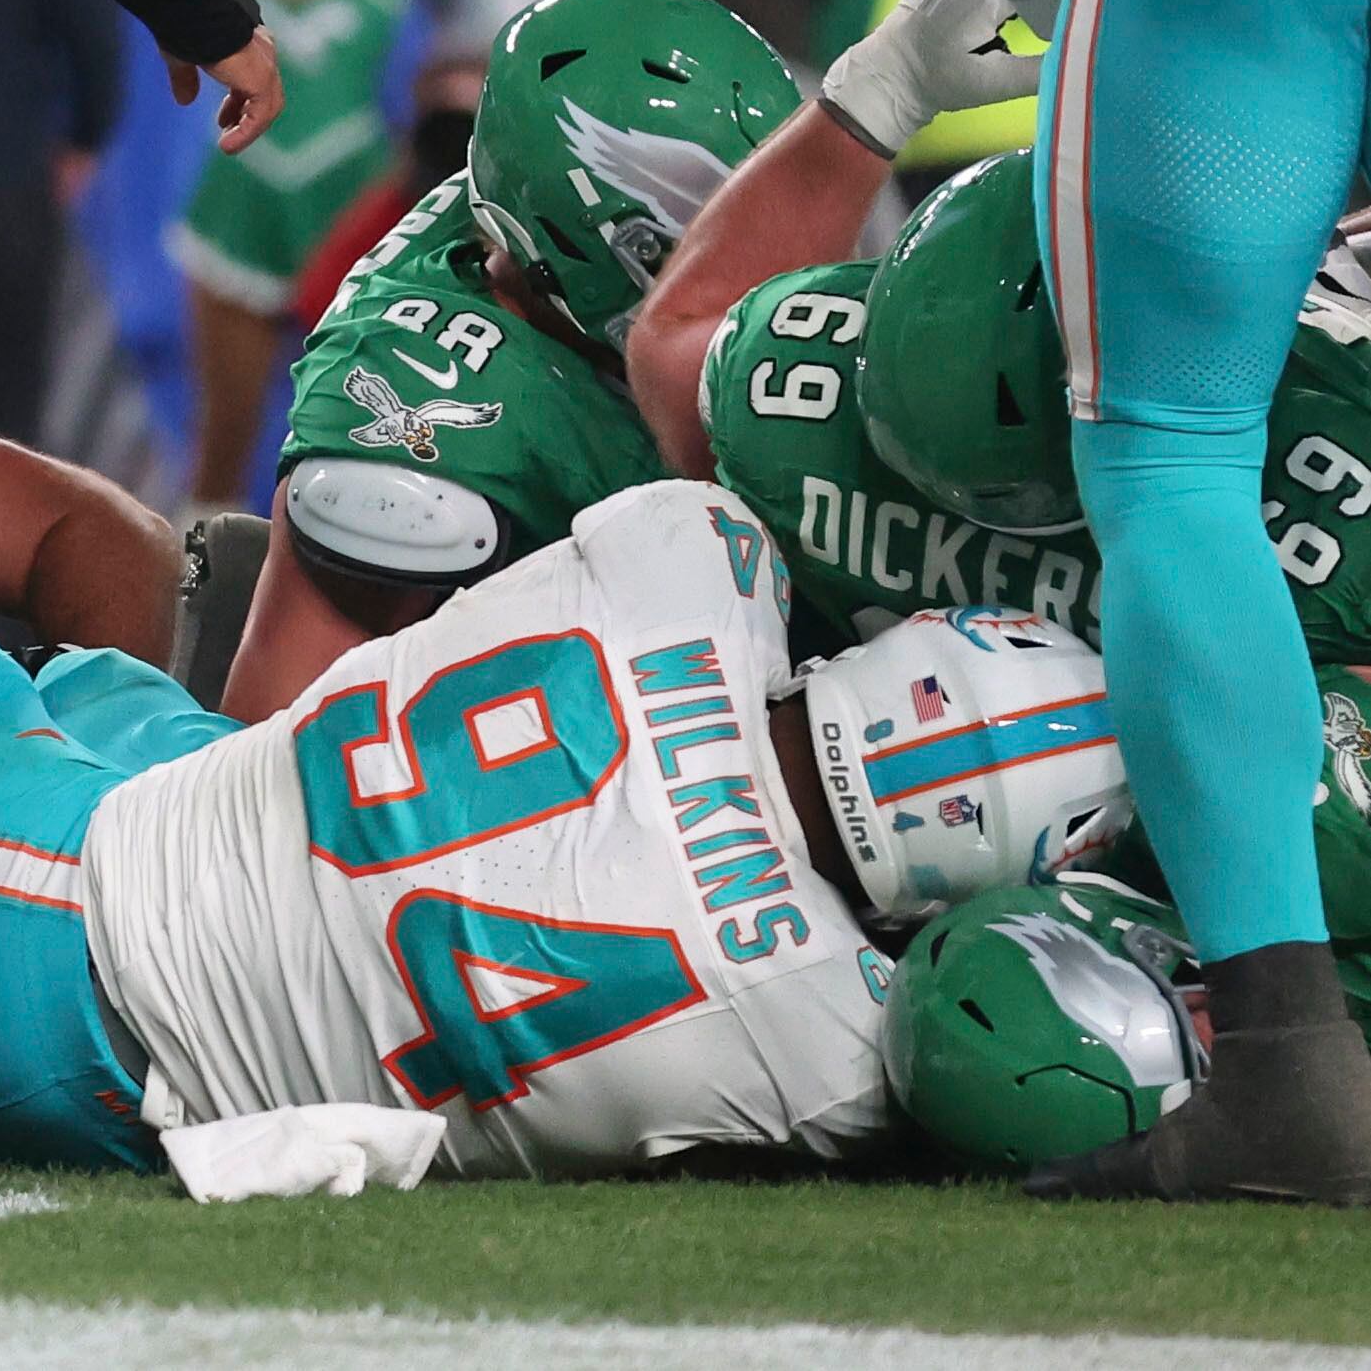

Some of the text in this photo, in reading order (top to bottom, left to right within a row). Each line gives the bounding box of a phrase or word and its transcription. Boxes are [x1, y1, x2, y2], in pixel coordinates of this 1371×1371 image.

[746, 290, 868, 421] 69
[294, 627, 708, 1112] 94
[628, 636, 811, 965] WILKINS
[822, 722, 877, 863] Dolphins
